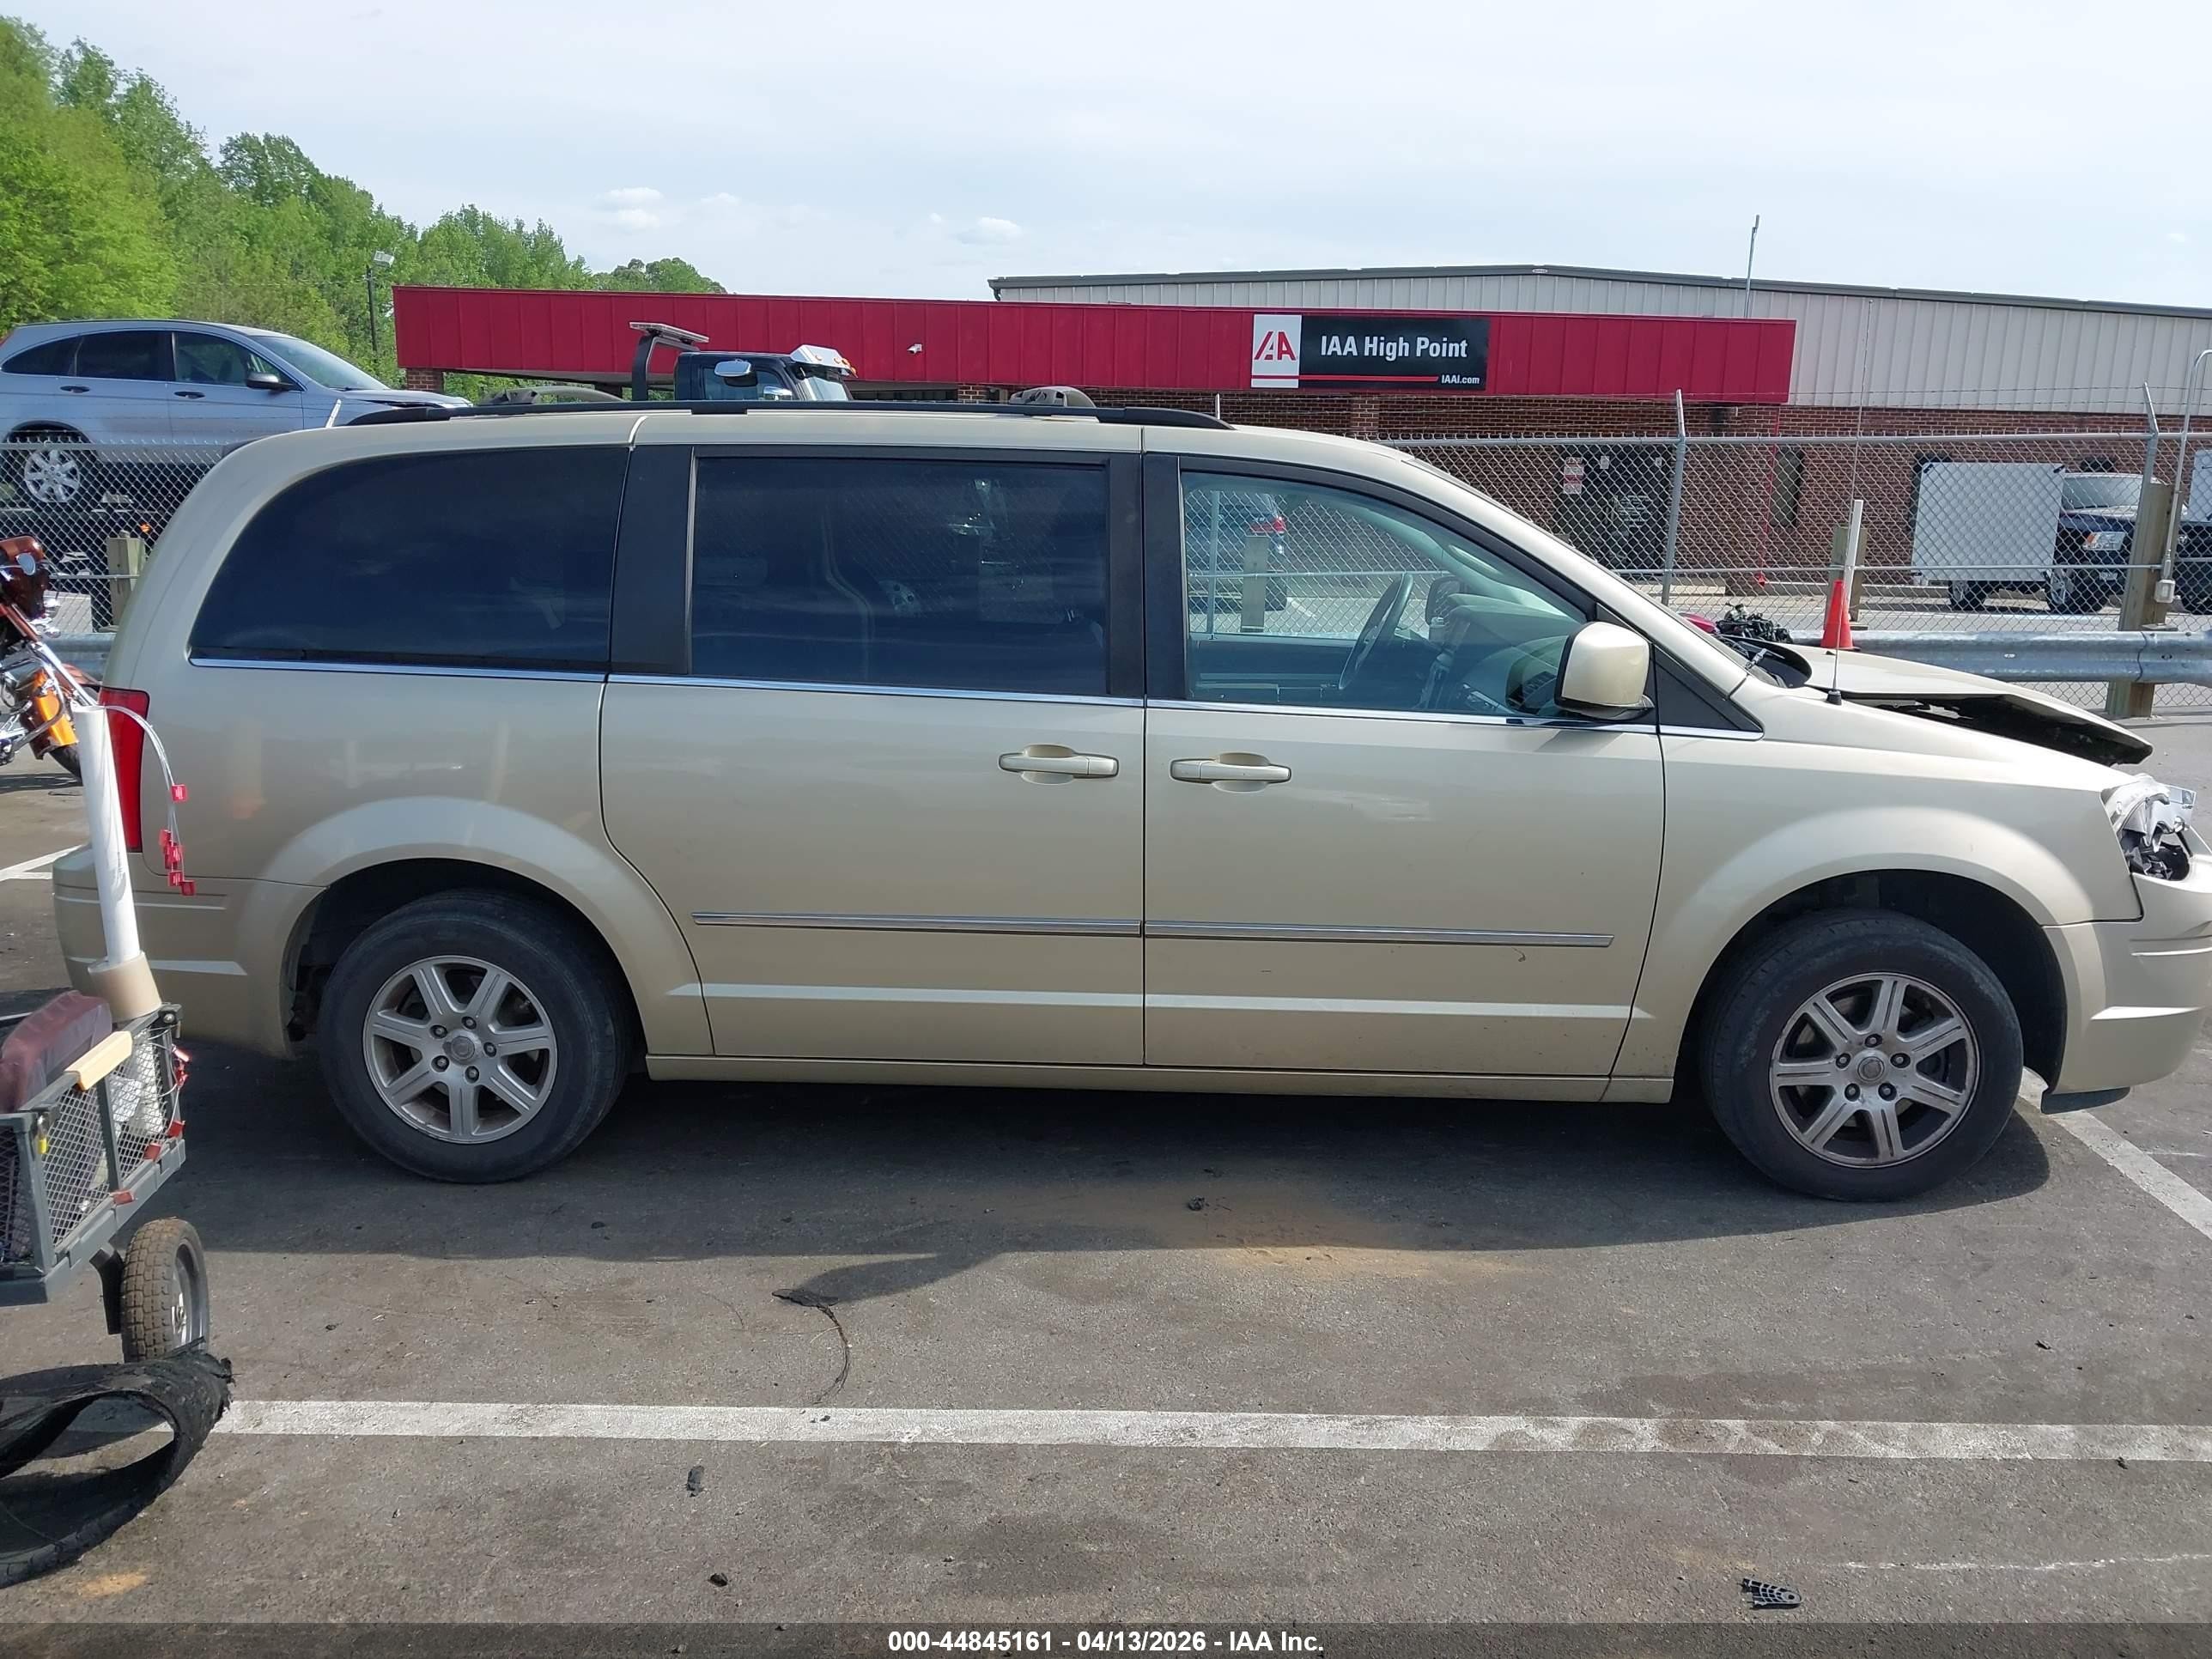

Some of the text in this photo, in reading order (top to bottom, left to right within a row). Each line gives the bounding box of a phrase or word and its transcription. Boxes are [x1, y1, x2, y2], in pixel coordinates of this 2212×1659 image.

[1320, 335, 1468, 362] IAA High Point
[1441, 374, 1480, 385] IAAI.com
